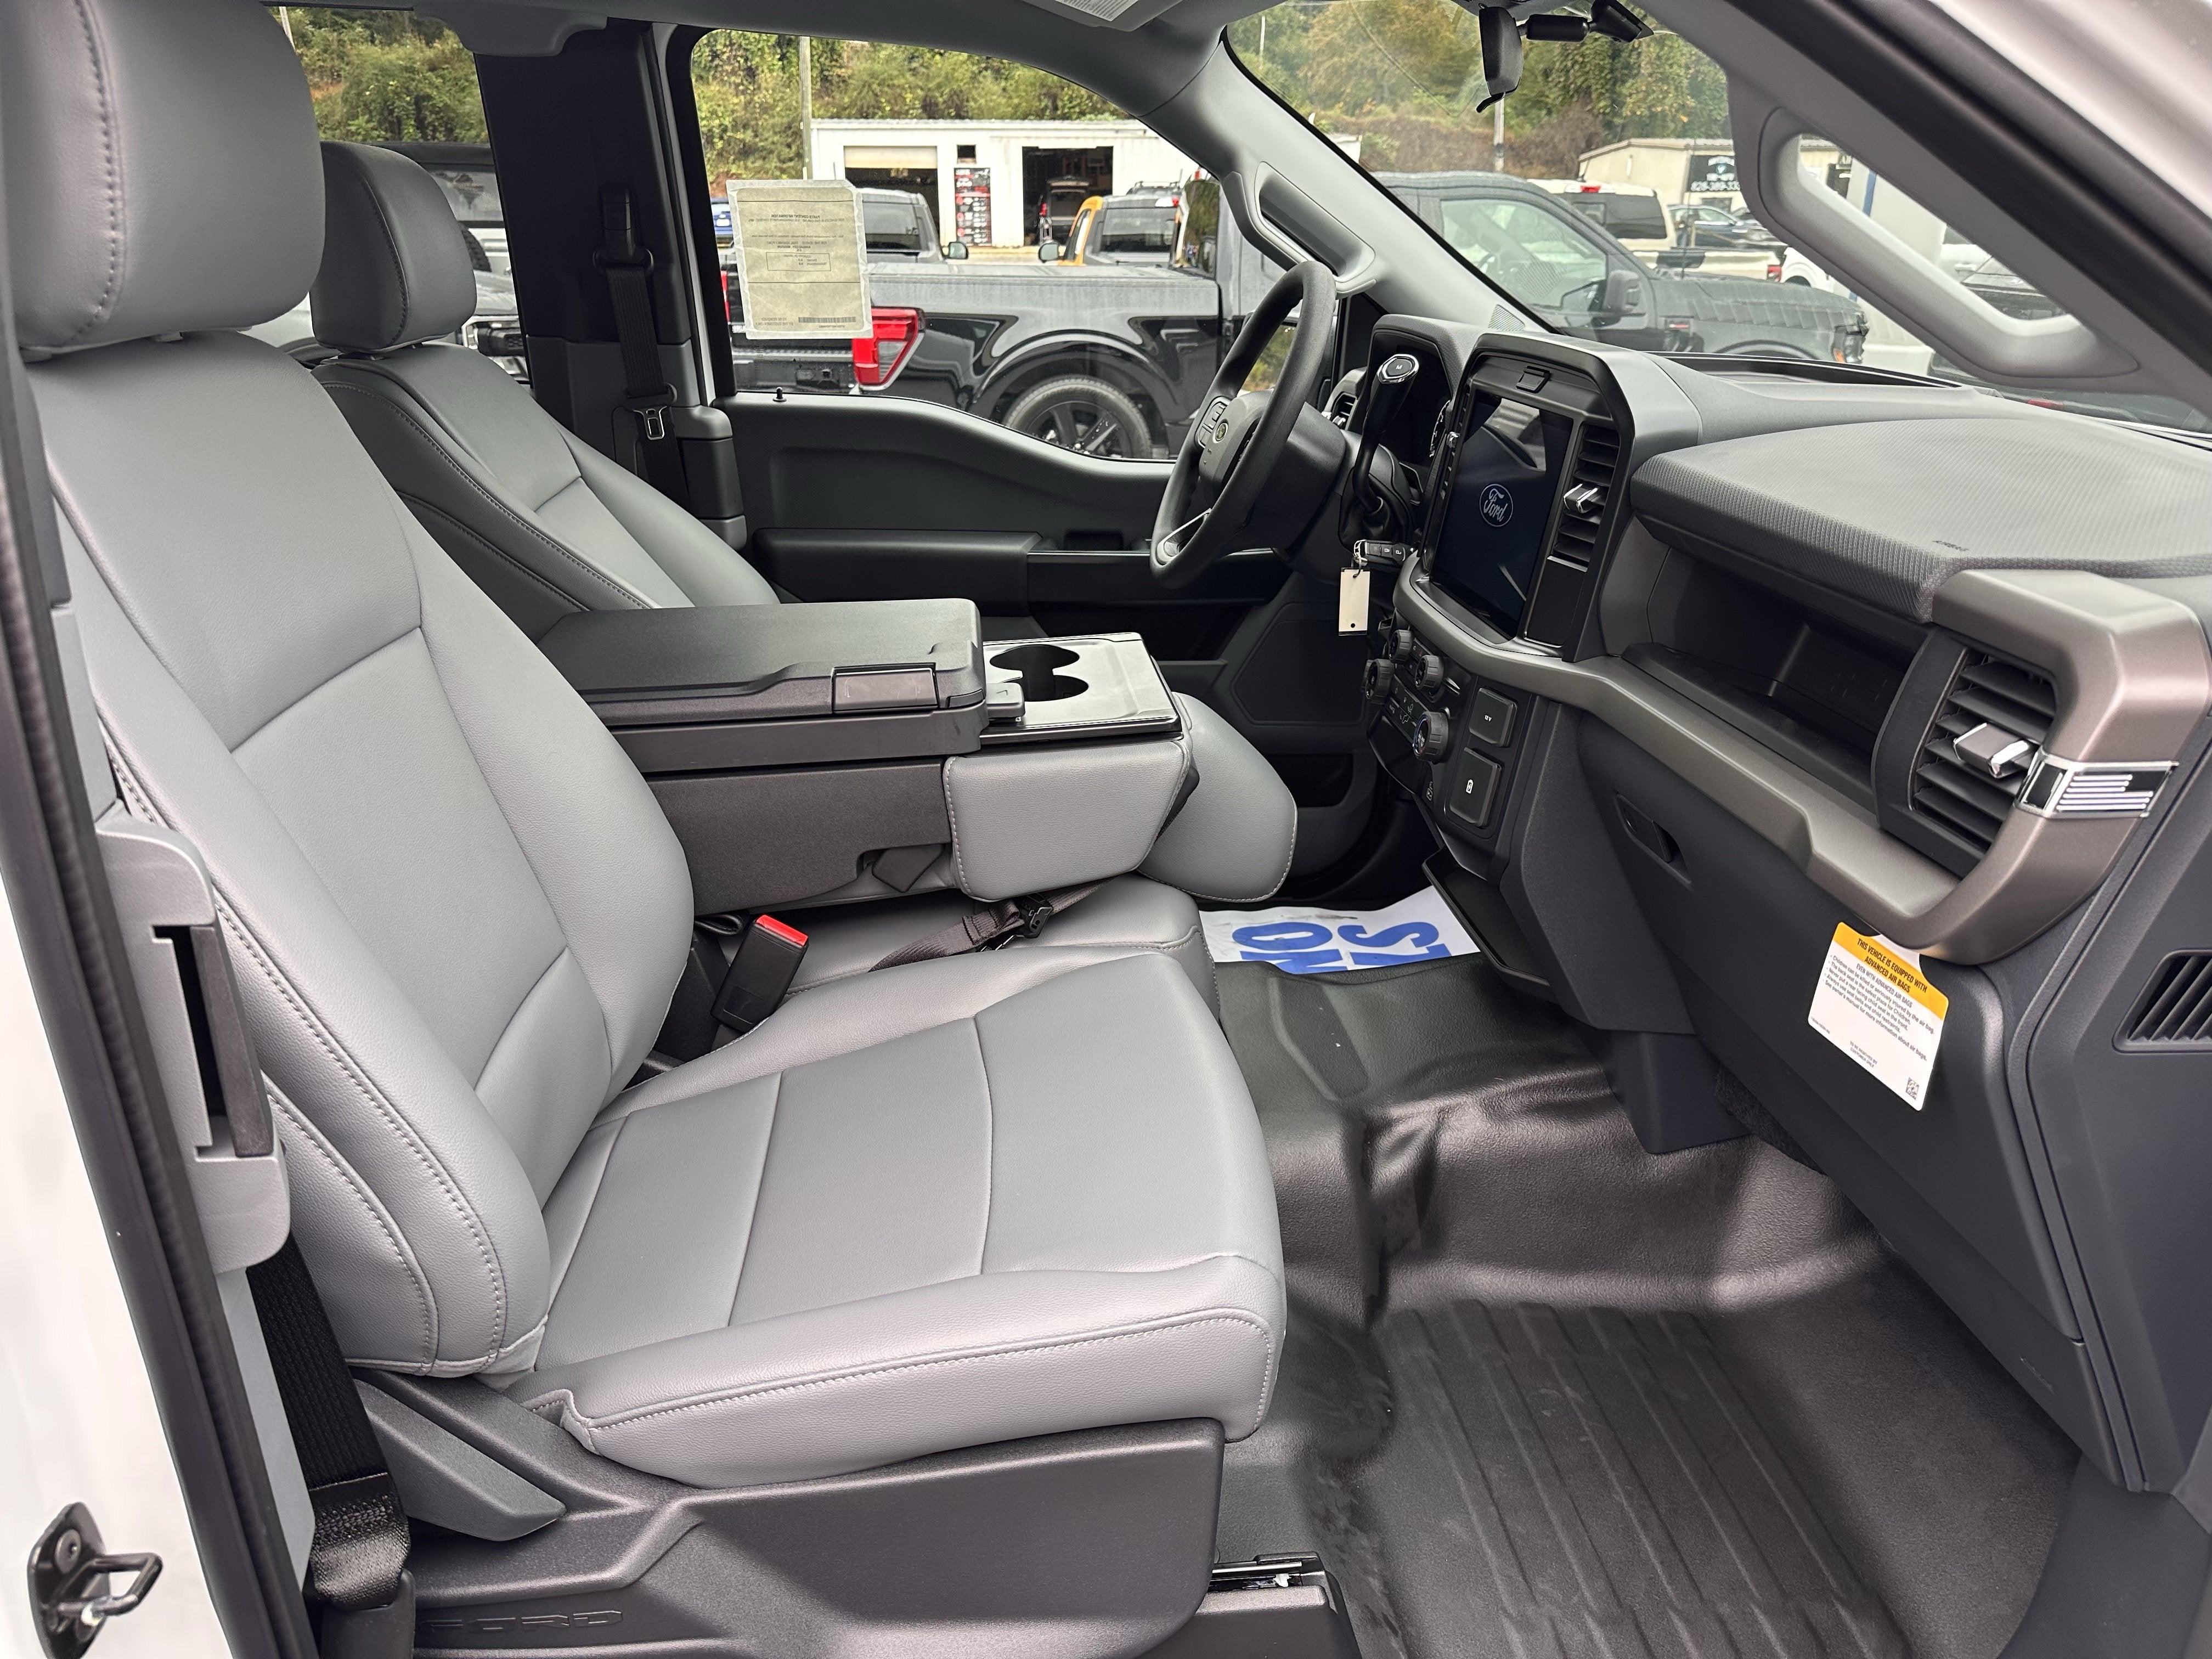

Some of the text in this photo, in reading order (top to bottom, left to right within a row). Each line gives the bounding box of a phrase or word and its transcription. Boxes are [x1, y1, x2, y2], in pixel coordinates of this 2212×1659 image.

[1483, 488, 1509, 522] Ford
[1856, 963, 1865, 973] EVEN
[1866, 970, 1875, 981] WITH
[1875, 978, 1894, 995] ADVANCED
[1901, 996, 1912, 1008] BAGS
[1857, 938, 1927, 992] THIS VEHICLE IS EQUIPPED WITH
[1864, 956, 1910, 992] ADVANCED AIR BAGS
[1826, 974, 1839, 986] Always
[1846, 989, 1854, 997] seat
[1854, 995, 1863, 1005] belts
[1871, 1008, 1881, 1018] child
[1881, 1015, 1900, 1033] restraints.
[1829, 967, 1839, 978] Never
[1856, 988, 1867, 1001] facing
[1867, 998, 1877, 1007] child
[1877, 1005, 1886, 1013] seat
[1897, 1019, 1908, 1030] front.
[1832, 955, 1847, 969] Children
[1859, 975, 1870, 986] killed
[1874, 987, 1892, 1003] seriously
[1892, 1000, 1906, 1013] injured
[1925, 1023, 1934, 1034] bag.
[1837, 967, 1846, 976] back
[1865, 988, 1876, 998] safest
[1876, 996, 1887, 1006] place
[1893, 1008, 1910, 1025] Children.
[1832, 986, 1846, 998] owner's
[1846, 996, 1859, 1009] manual
[1865, 1011, 1875, 1021] more
[1875, 1019, 1897, 1038] information
[1897, 1036, 1909, 1047] about
[1915, 1048, 1927, 1060] bags.
[426, 1610, 623, 1633] FORD
